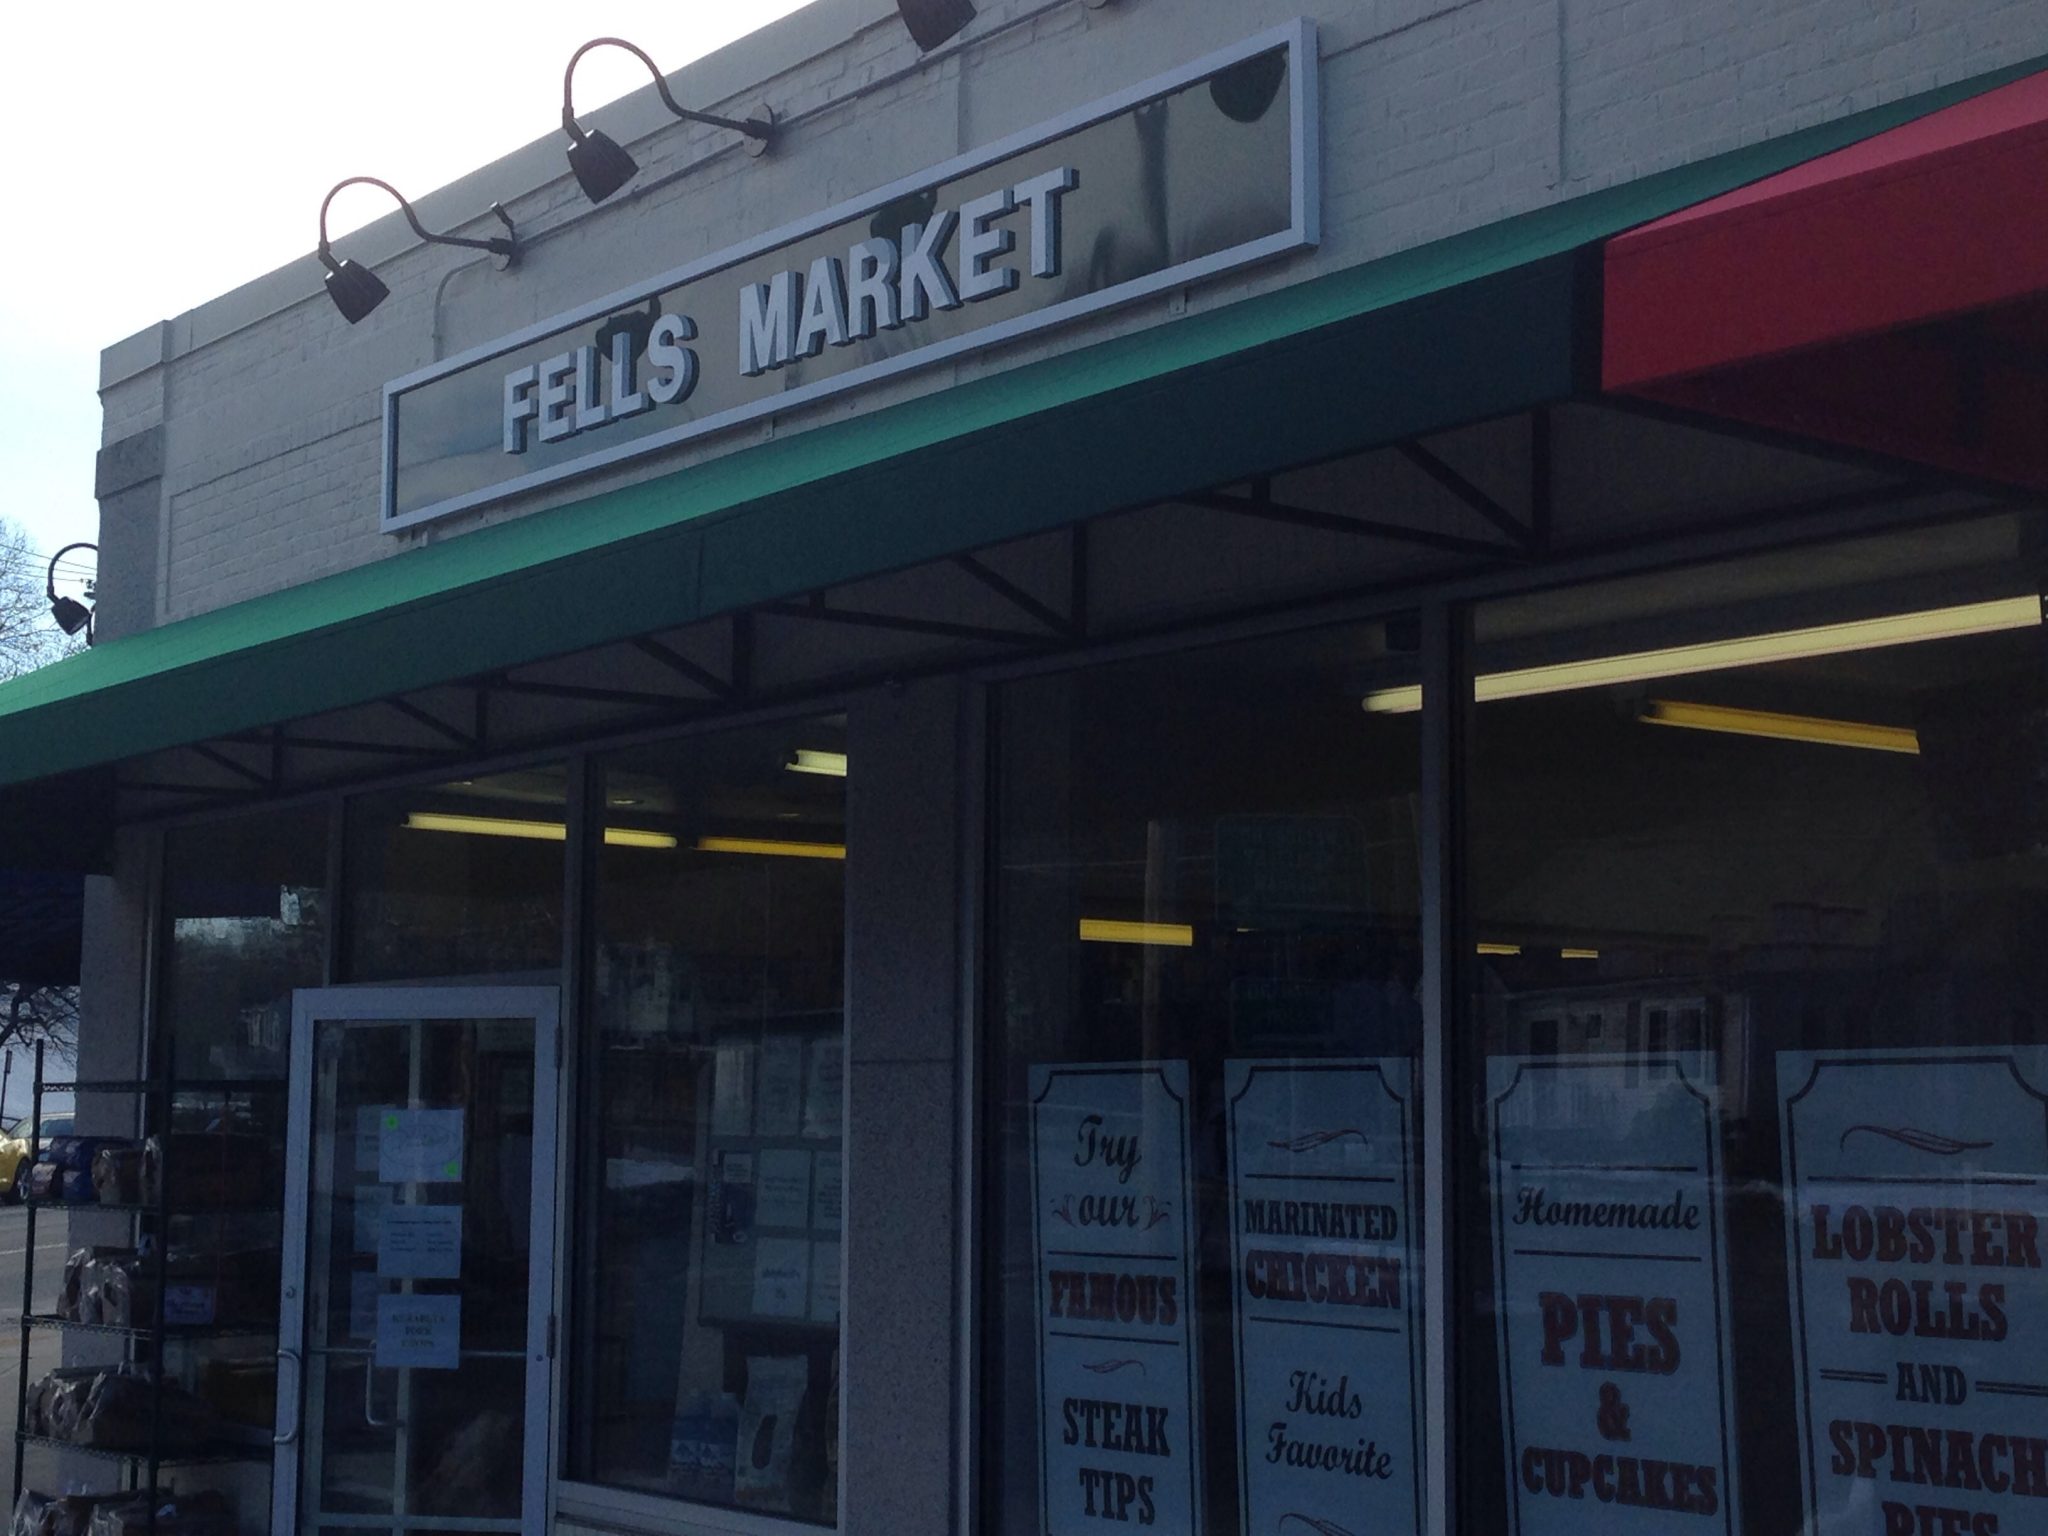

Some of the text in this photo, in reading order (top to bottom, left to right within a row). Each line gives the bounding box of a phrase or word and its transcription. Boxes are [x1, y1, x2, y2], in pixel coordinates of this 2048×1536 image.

[503, 167, 1079, 453] FELLS MARKET
[1074, 1115, 1141, 1183] Try
[1079, 1195, 1139, 1227] our
[1245, 1202, 1398, 1240] MARINATED
[1513, 1188, 1700, 1230] Homemade
[1811, 1205, 2041, 1267] LOBSTER
[1048, 1271, 1178, 1326] FAMOUS
[1246, 1250, 1400, 1308] CHICKEN
[1539, 1292, 1681, 1374] PIES
[1848, 1277, 2008, 1342] ROLLS
[1286, 1371, 1362, 1419] Kids
[1597, 1382, 1631, 1441] &
[1896, 1362, 1968, 1406] AND
[1063, 1398, 1171, 1457] STEAK
[1266, 1422, 1393, 1479] Favorite
[1521, 1447, 1718, 1515] CUPCAKES
[1829, 1419, 2048, 1498] SPINACH
[1079, 1468, 1154, 1525] TIPS
